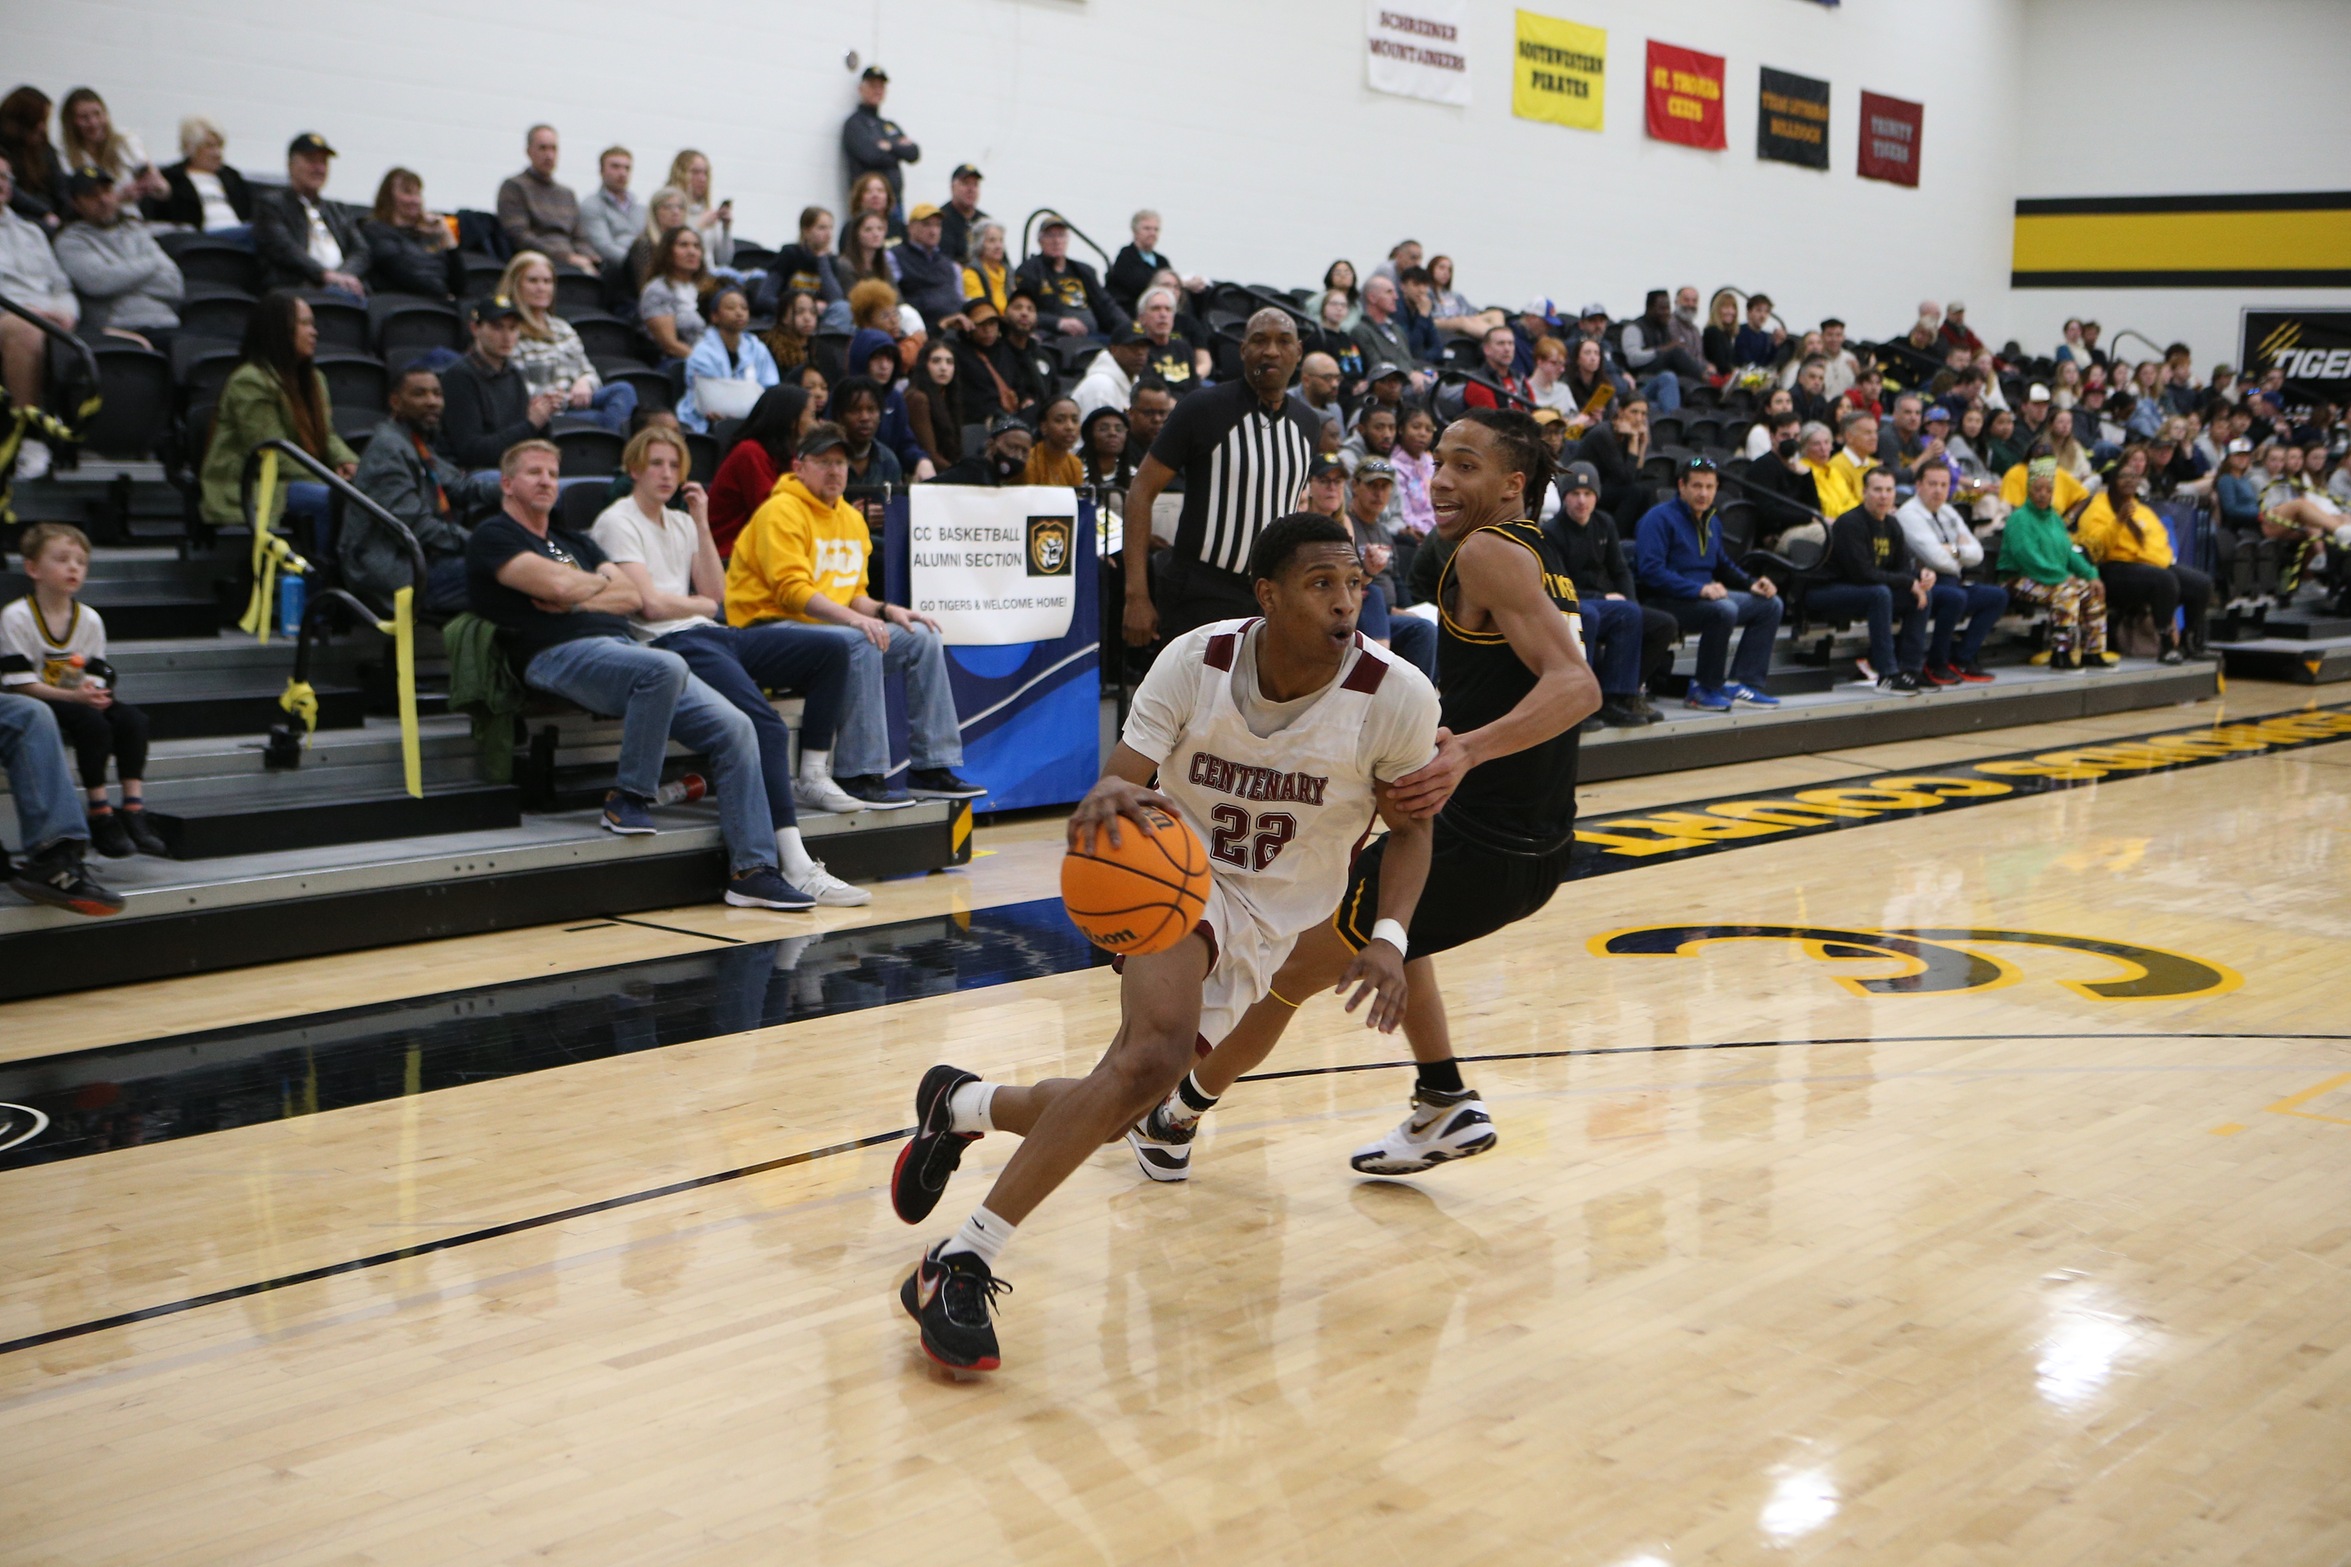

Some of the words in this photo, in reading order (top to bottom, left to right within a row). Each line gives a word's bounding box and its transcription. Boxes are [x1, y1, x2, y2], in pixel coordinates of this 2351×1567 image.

[1530, 69, 1590, 99] PIRATES
[2270, 347, 2351, 379] TIGE
[913, 526, 932, 542] CC
[939, 526, 1021, 542] BASKETBALL
[913, 553, 962, 568] ALUMNI
[965, 552, 1023, 568] SECTION
[920, 600, 936, 612] GO
[938, 599, 972, 611] TIGERS
[974, 599, 981, 611] &
[983, 598, 1034, 610] WELCOME
[1036, 597, 1067, 609] HOME!
[1188, 751, 1329, 807] CENTENARY
[1574, 776, 2014, 857] COURT
[1210, 803, 1297, 872] 22
